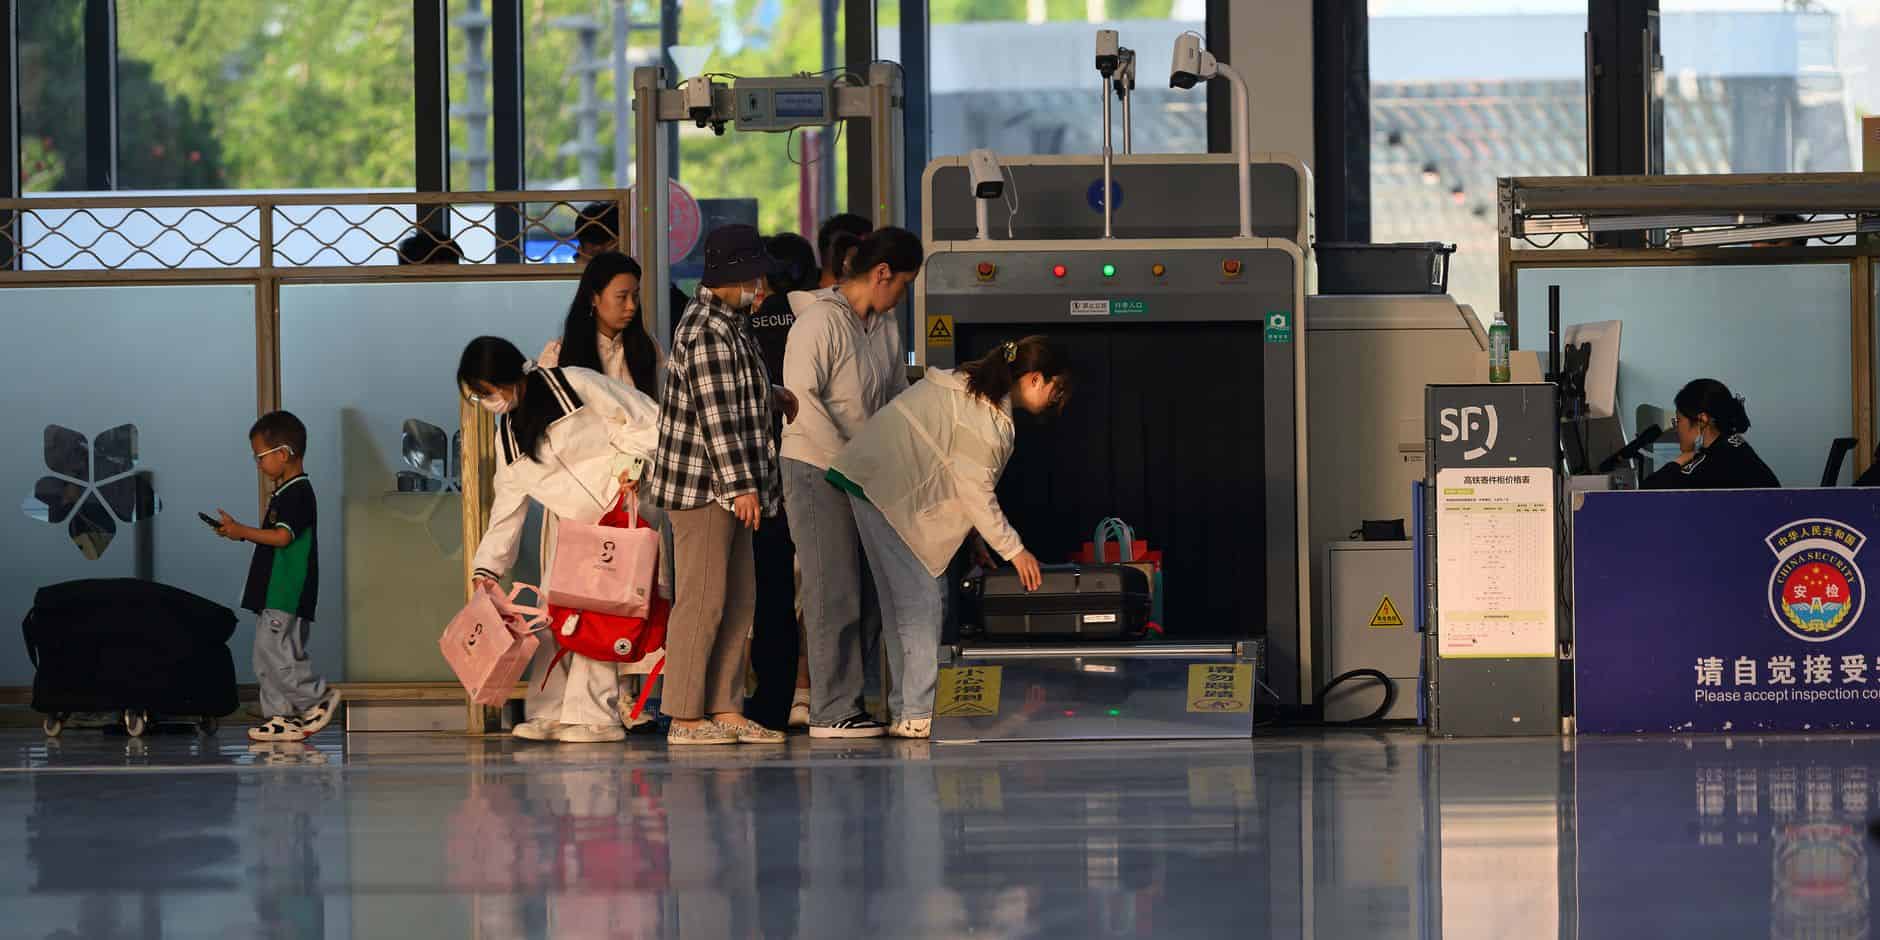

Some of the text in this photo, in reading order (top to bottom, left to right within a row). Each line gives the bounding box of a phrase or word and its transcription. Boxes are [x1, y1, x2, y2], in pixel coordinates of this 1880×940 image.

[1777, 525, 1857, 547] 中华人民共和国
[1776, 551, 1856, 584] CHINA SECURITY
[1695, 654, 1880, 686] 请自觉接受
[1695, 687, 1880, 704] Please accept inspection co
